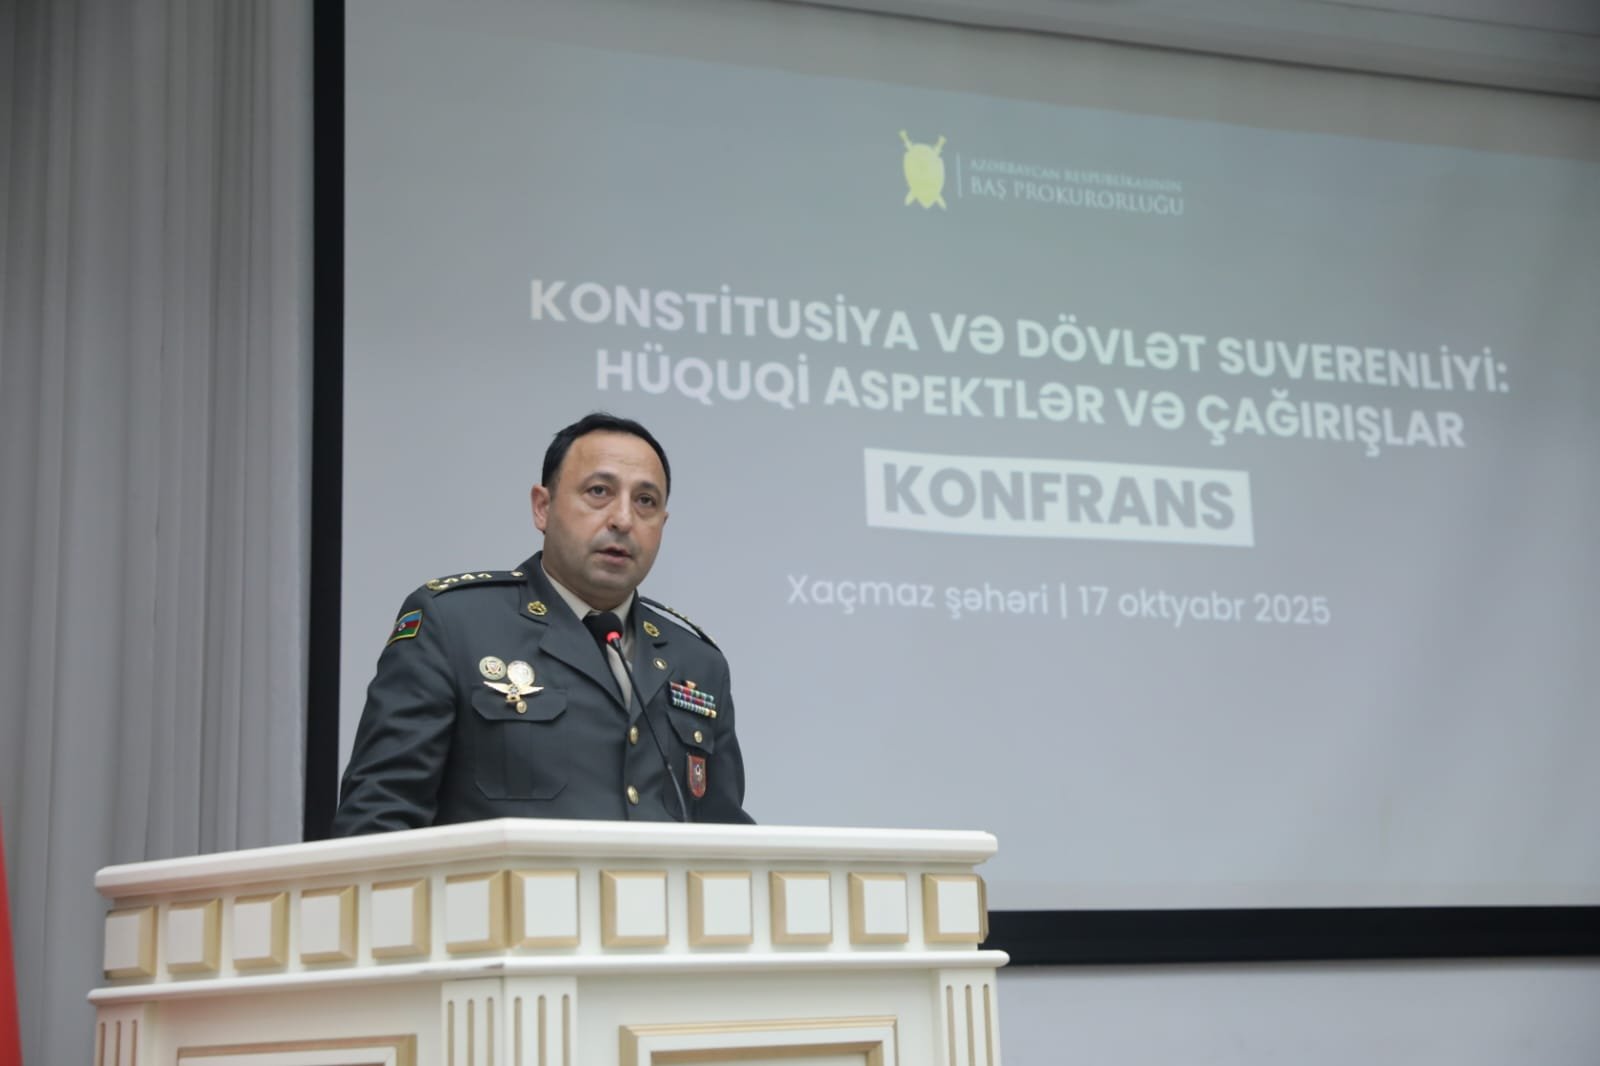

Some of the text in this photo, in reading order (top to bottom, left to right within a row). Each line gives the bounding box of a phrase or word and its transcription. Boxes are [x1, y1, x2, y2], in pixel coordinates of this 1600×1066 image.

[970, 175, 1185, 217] BAŞ PROKURORLUĞU
[529, 279, 1510, 394] KONSTİTUSİYA VƏ DÖVLƏT SUVERENLİYİ:
[596, 342, 1467, 459] HÜQUQİ ASPEKTLƏR VƏ ÇAĞIRIŞLAR
[882, 462, 1236, 531] KONFRANS
[786, 574, 936, 615] Xaçmaz
[945, 583, 1050, 621] şəhəri
[1079, 588, 1110, 617] 17
[1117, 588, 1246, 629] oktyabr
[1253, 593, 1332, 626] 2025
